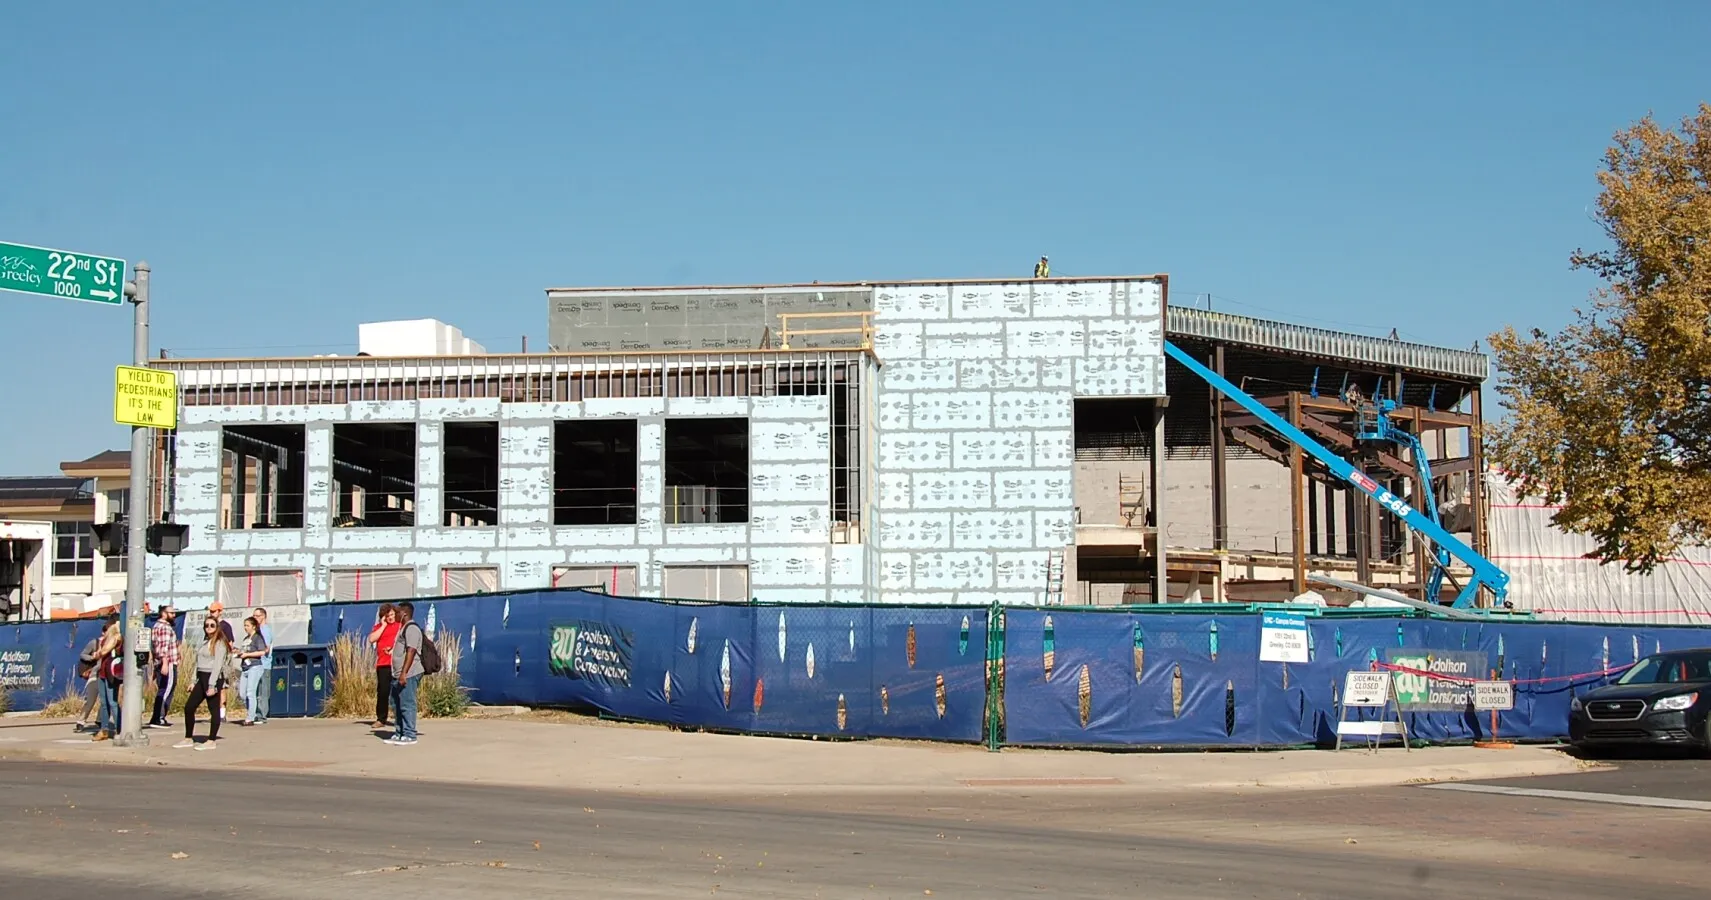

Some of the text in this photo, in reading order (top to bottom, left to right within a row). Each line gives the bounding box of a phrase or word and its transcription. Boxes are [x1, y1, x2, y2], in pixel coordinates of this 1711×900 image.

[47, 252, 118, 287] 22nd St
[54, 280, 81, 297] 1000
[128, 371, 166, 385] YIELD TO
[118, 383, 173, 399] PEDESTRIANS
[128, 398, 163, 411] IT'S THE
[137, 412, 154, 423] LAW
[1379, 491, 1412, 516] S-65
[1354, 682, 1379, 690] CLOSED
[1477, 686, 1509, 694] SIDEWALK
[1480, 696, 1506, 705] CLOSED
